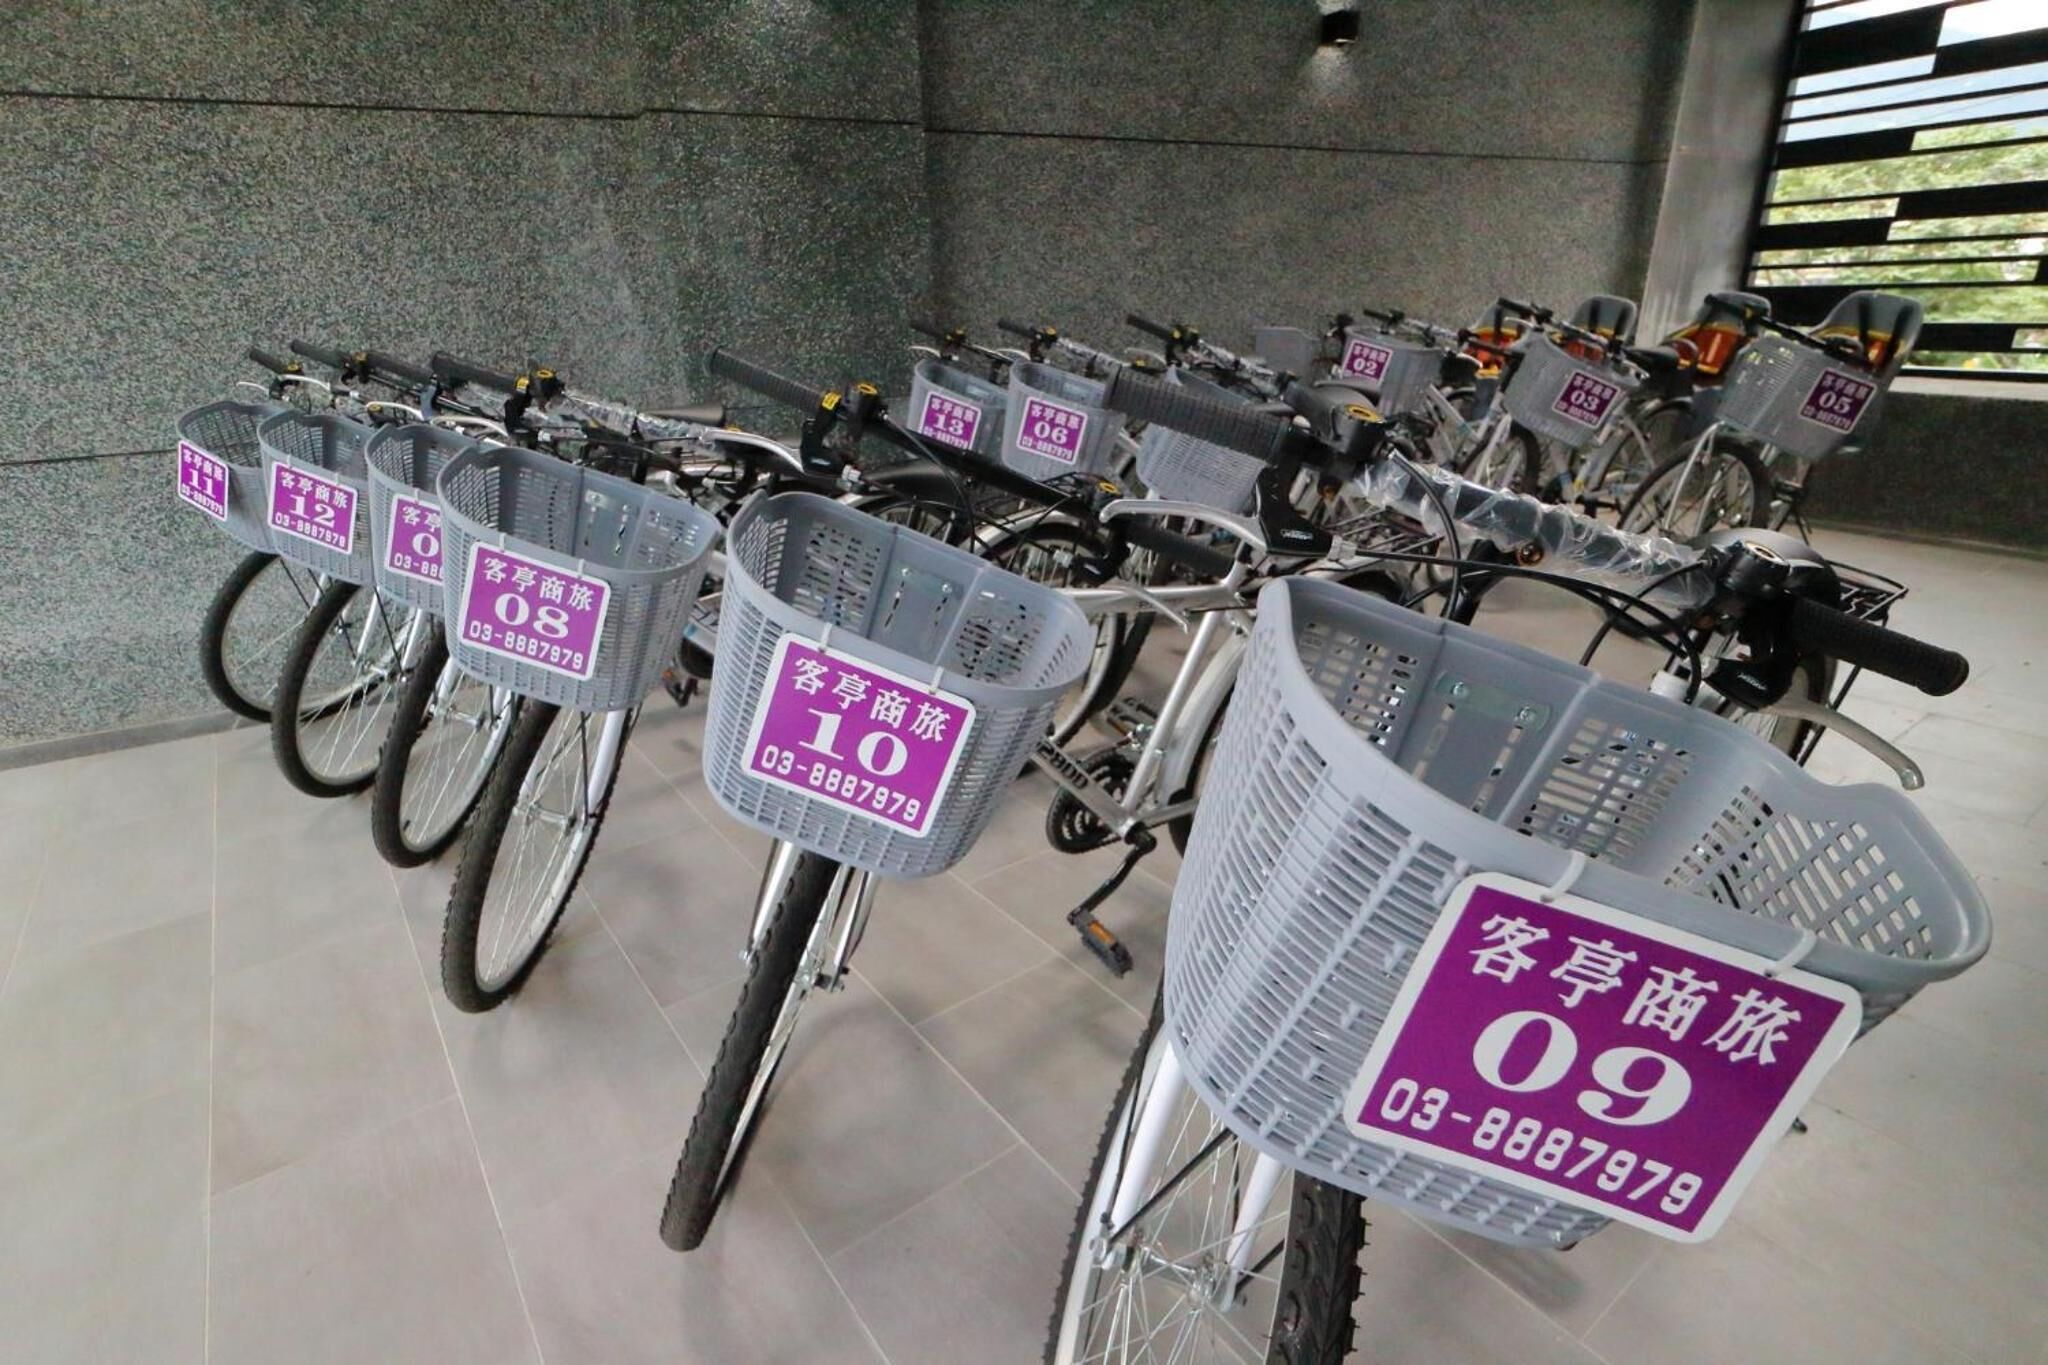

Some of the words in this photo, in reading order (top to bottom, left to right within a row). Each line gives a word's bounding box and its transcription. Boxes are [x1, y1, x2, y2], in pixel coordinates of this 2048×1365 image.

[1353, 358, 1378, 375] 02
[933, 412, 964, 435] 13
[1570, 389, 1600, 412] 03
[1818, 390, 1853, 414] 05
[1034, 420, 1068, 445] 06
[189, 468, 216, 499] 11
[281, 471, 348, 508] 客亭商旅
[289, 493, 336, 528] 12
[482, 557, 594, 611] 客亭商旅
[495, 592, 569, 639] 08
[469, 620, 584, 669] 03-8887979
[791, 658, 951, 743] 客亭商旅
[798, 708, 908, 776] 10
[760, 744, 921, 822] 03-8887979
[1469, 913, 1801, 1066] 客亭商旅
[1473, 1011, 1692, 1126] 09
[1381, 1078, 1702, 1214] 03-8887979
